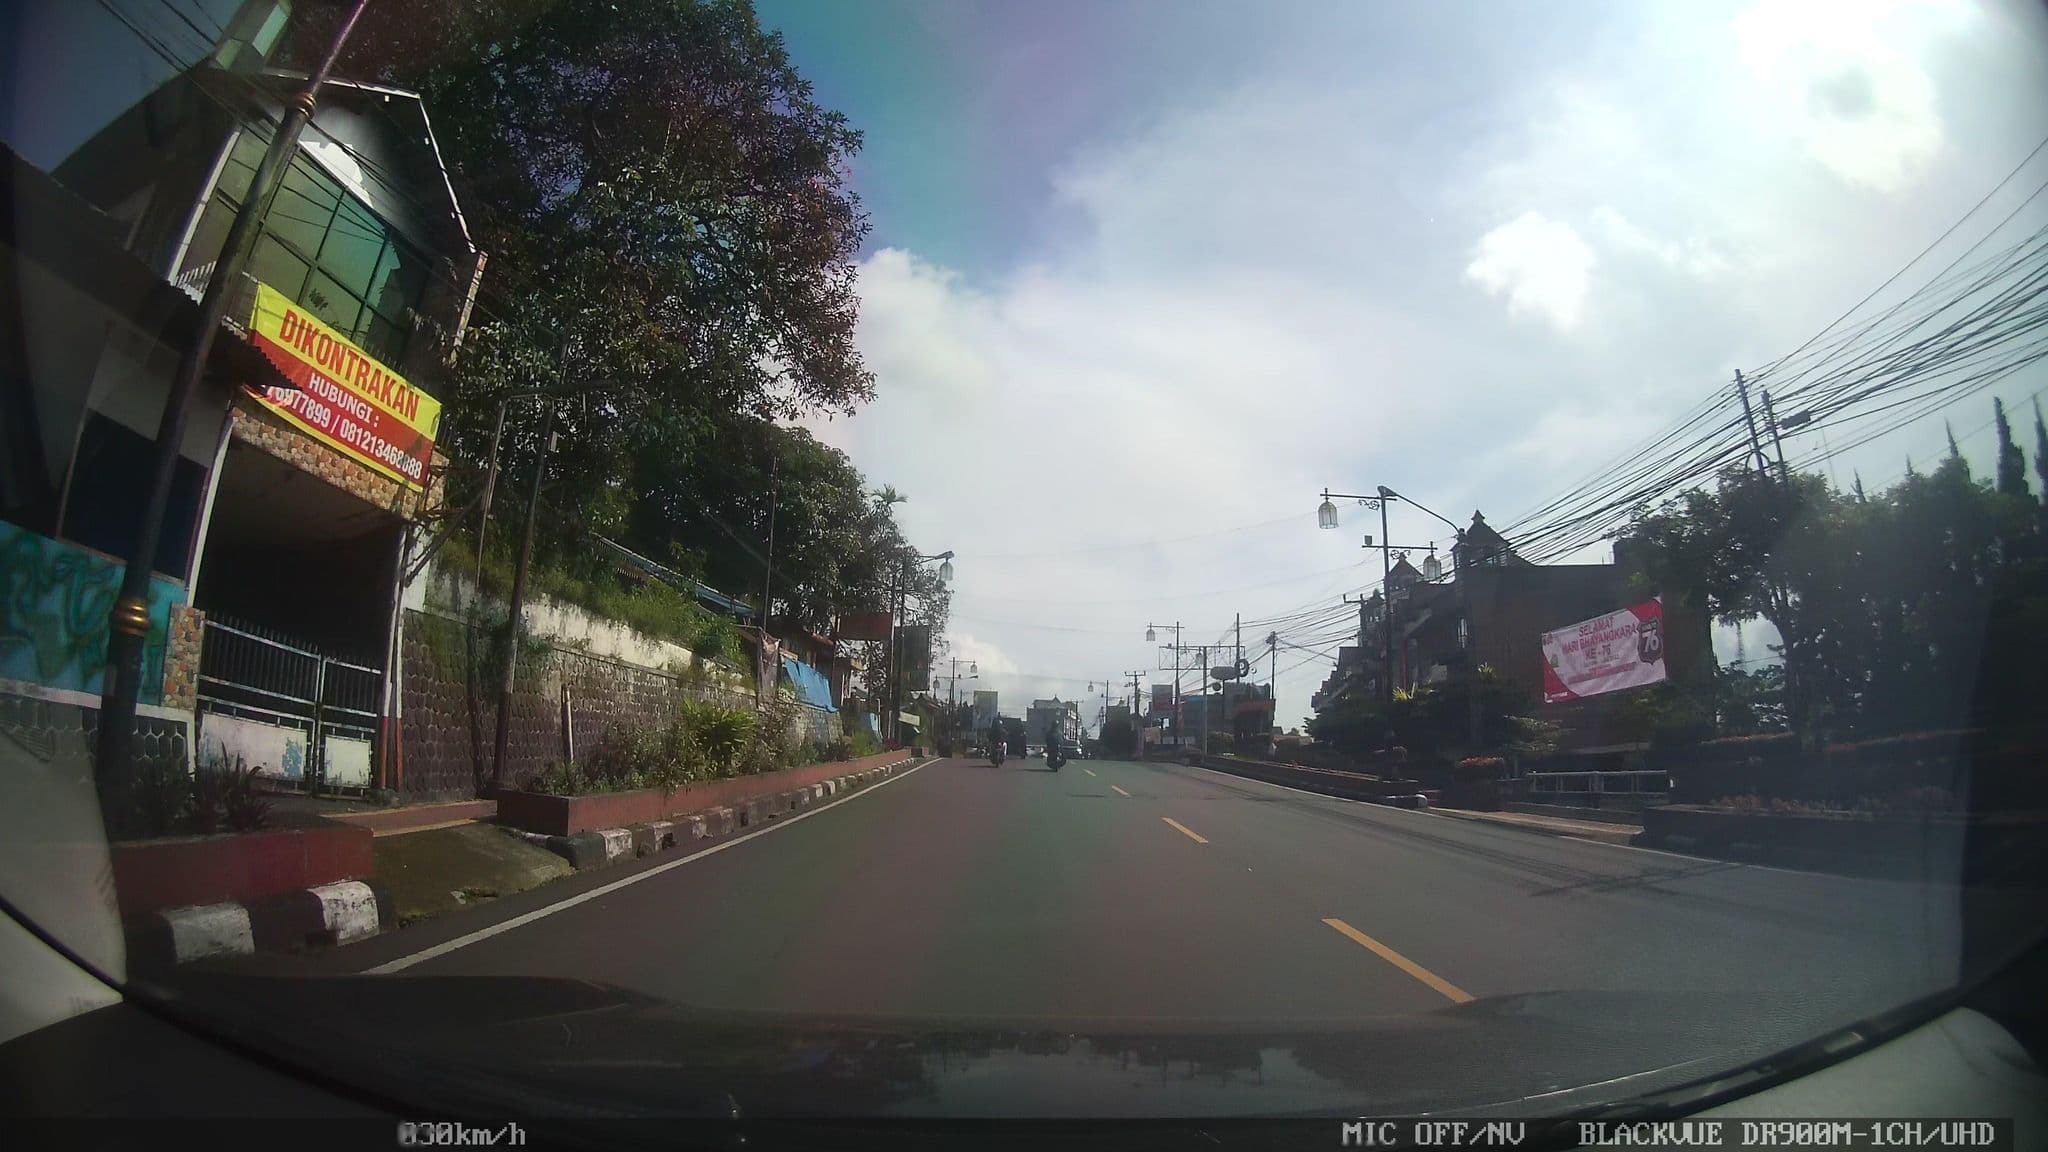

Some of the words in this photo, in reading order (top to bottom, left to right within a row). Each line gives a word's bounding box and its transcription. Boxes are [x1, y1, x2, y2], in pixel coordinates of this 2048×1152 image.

[279, 309, 420, 422] DIKONTRAKAN
[309, 372, 372, 421] HUBUNGI
[1578, 616, 1614, 637] SELAMAT
[1641, 629, 1659, 653] 76
